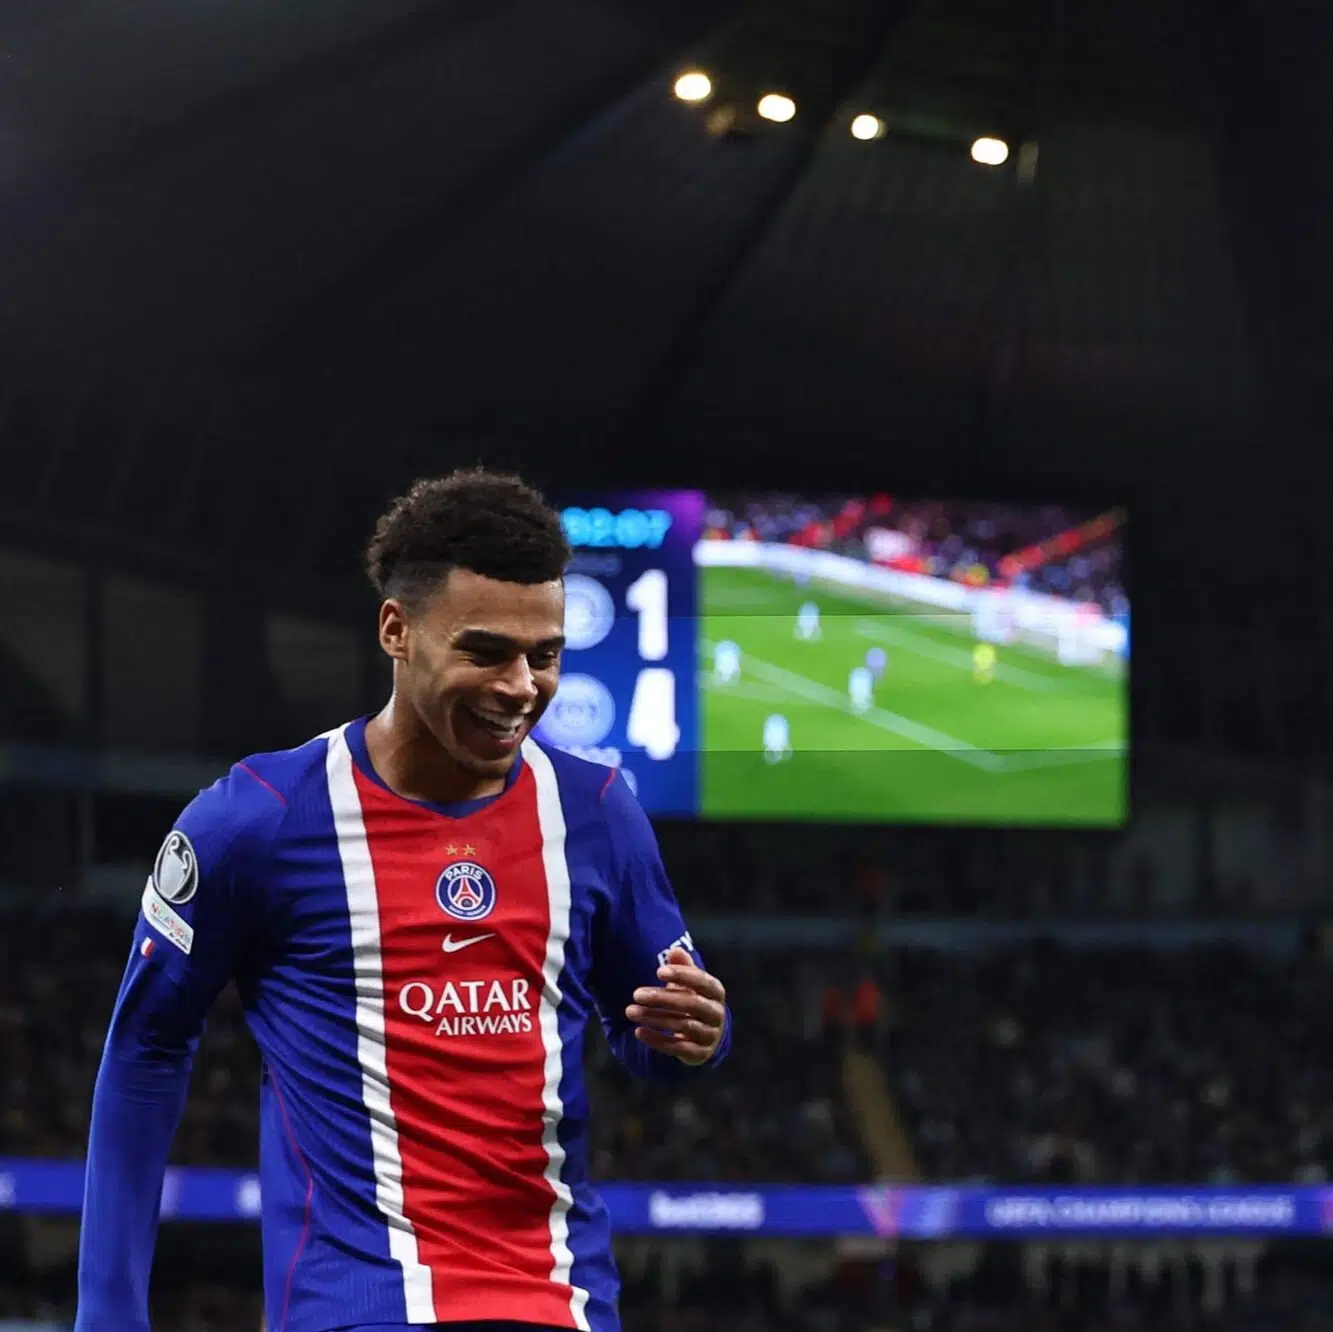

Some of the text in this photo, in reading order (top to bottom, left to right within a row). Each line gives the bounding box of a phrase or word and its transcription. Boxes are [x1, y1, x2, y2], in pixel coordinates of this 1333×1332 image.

[626, 568, 669, 661] 1
[626, 667, 681, 761] 4
[444, 865, 484, 881] PARIS
[399, 979, 532, 1022] QATAR
[435, 1012, 533, 1037] AIRWAYS
